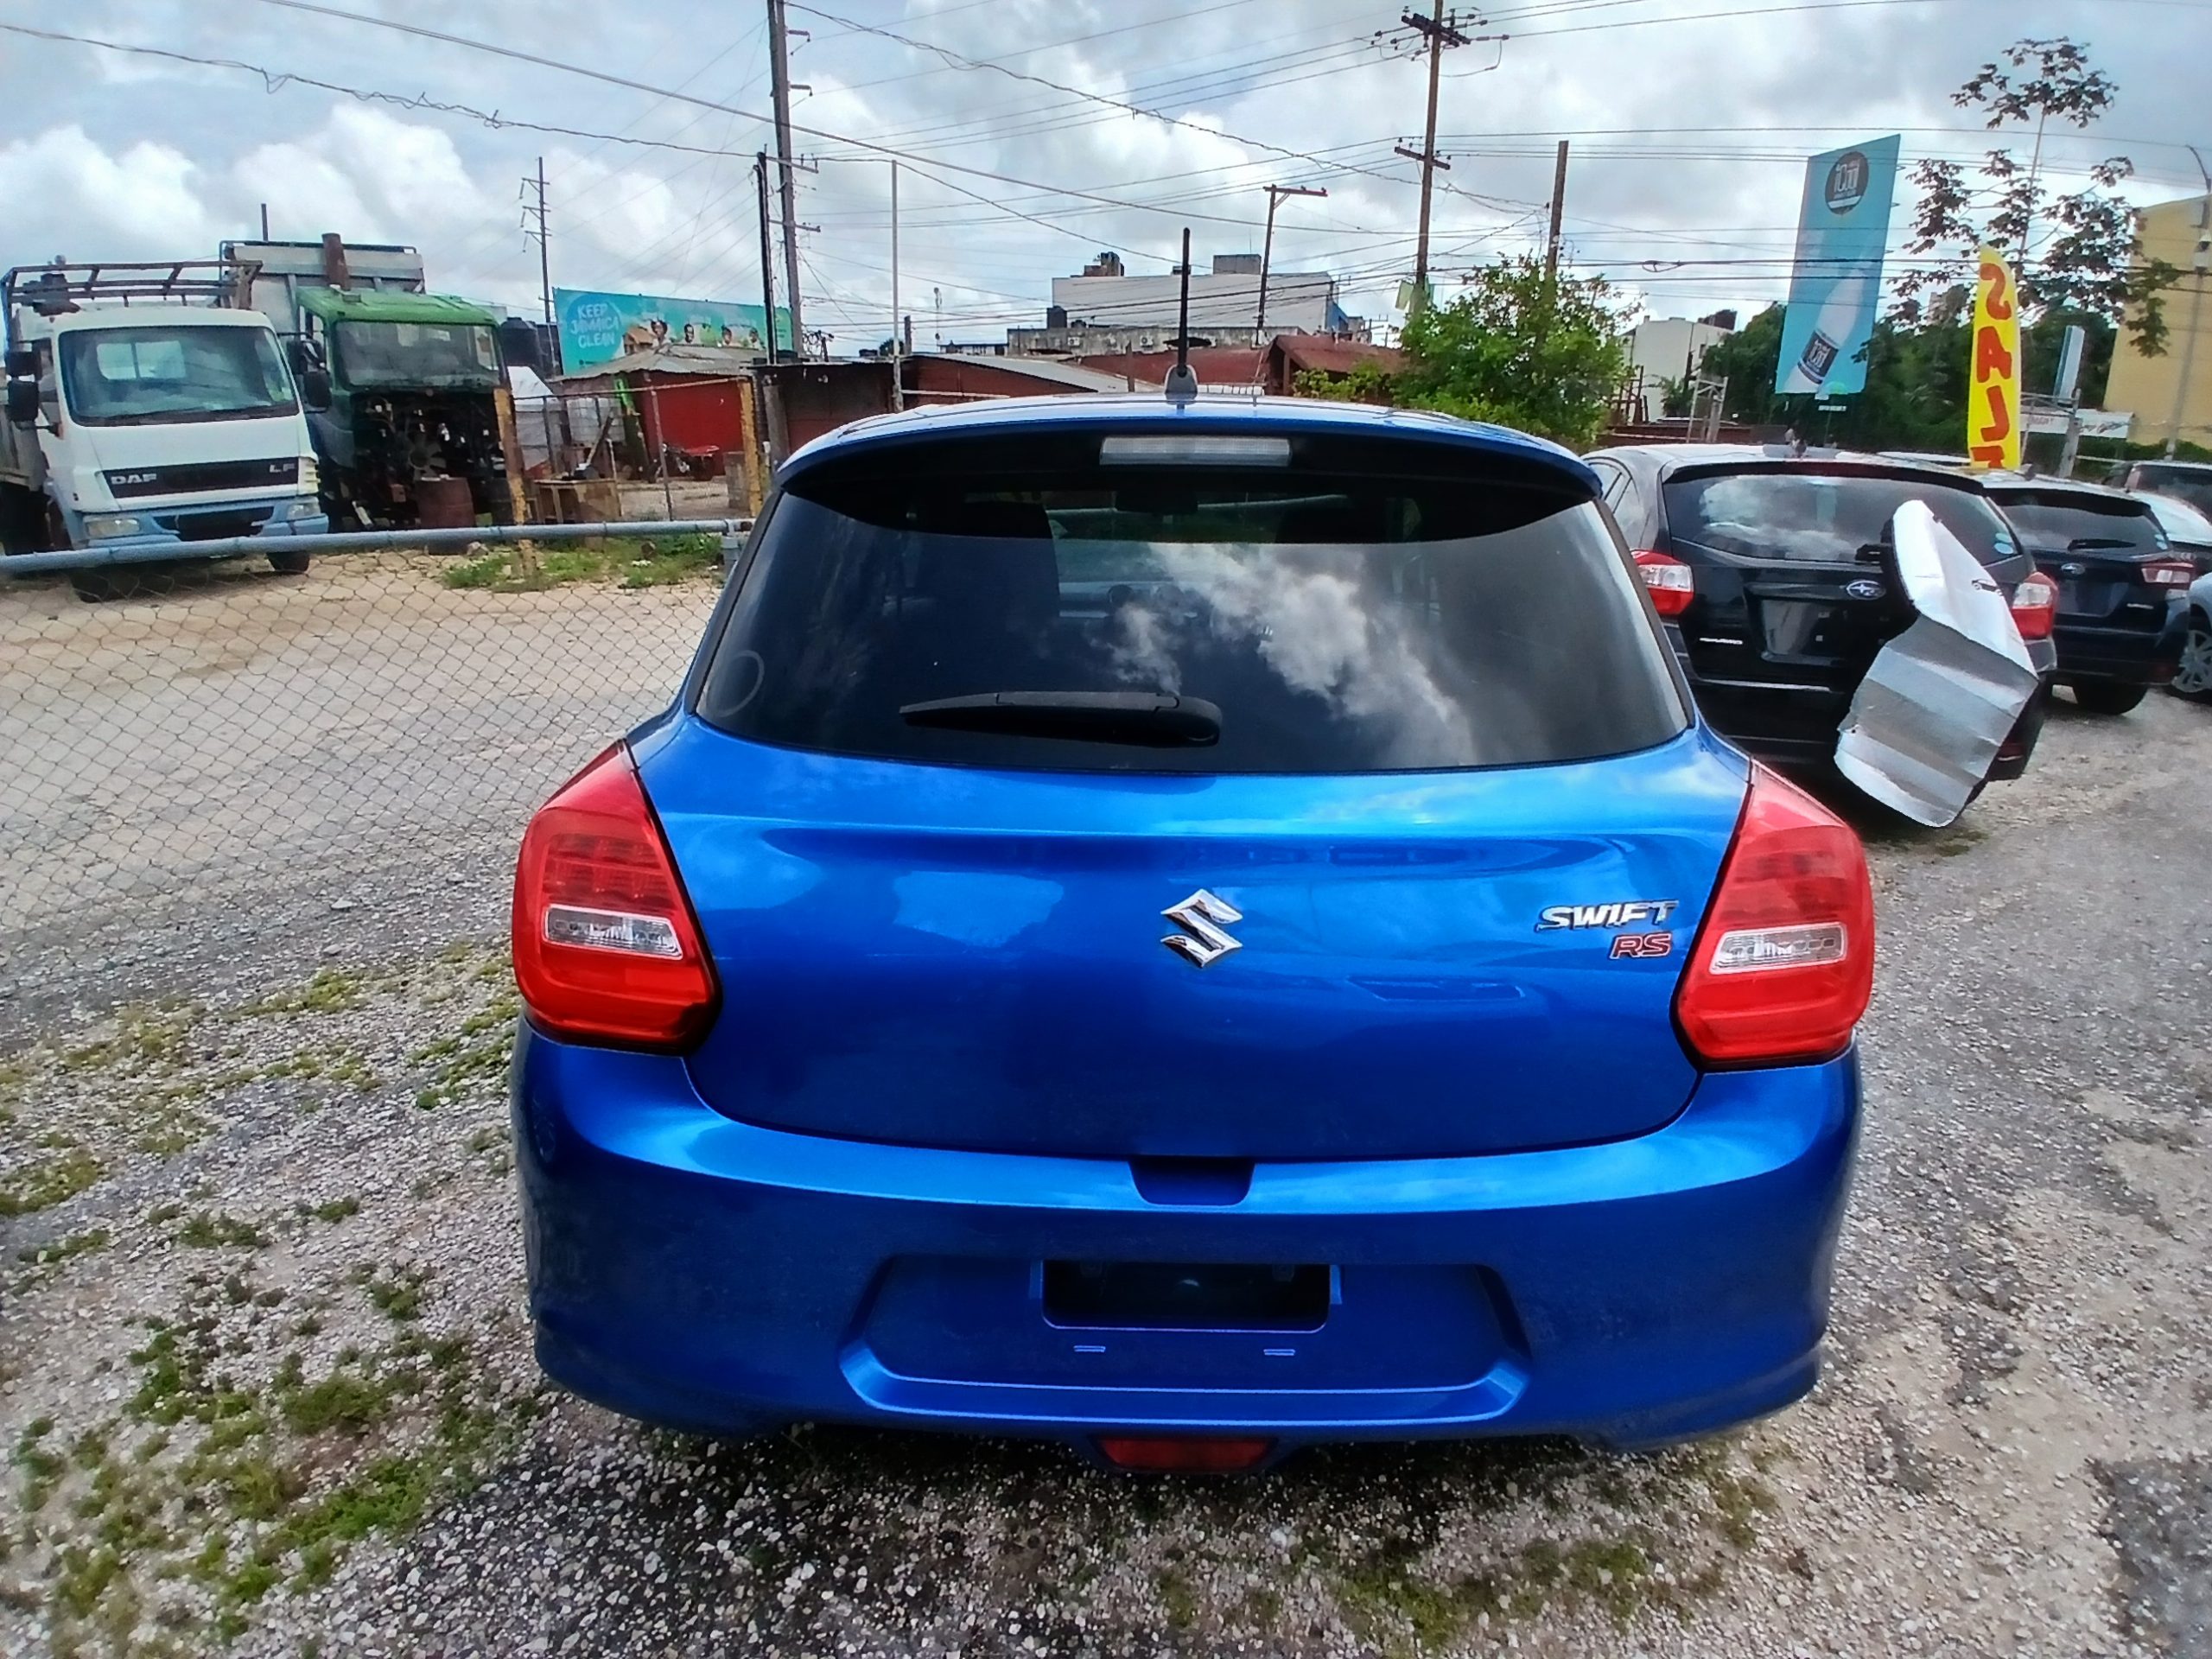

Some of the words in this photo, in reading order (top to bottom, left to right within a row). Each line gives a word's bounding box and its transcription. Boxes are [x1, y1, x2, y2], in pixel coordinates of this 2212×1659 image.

[577, 303, 608, 319] KEEP
[570, 316, 620, 335] JAMAICA
[577, 332, 615, 349] CLEAN
[110, 473, 157, 486] DAF
[269, 463, 296, 474] LF
[1535, 899, 1679, 933] SWIFT
[1608, 931, 1674, 960] RS
